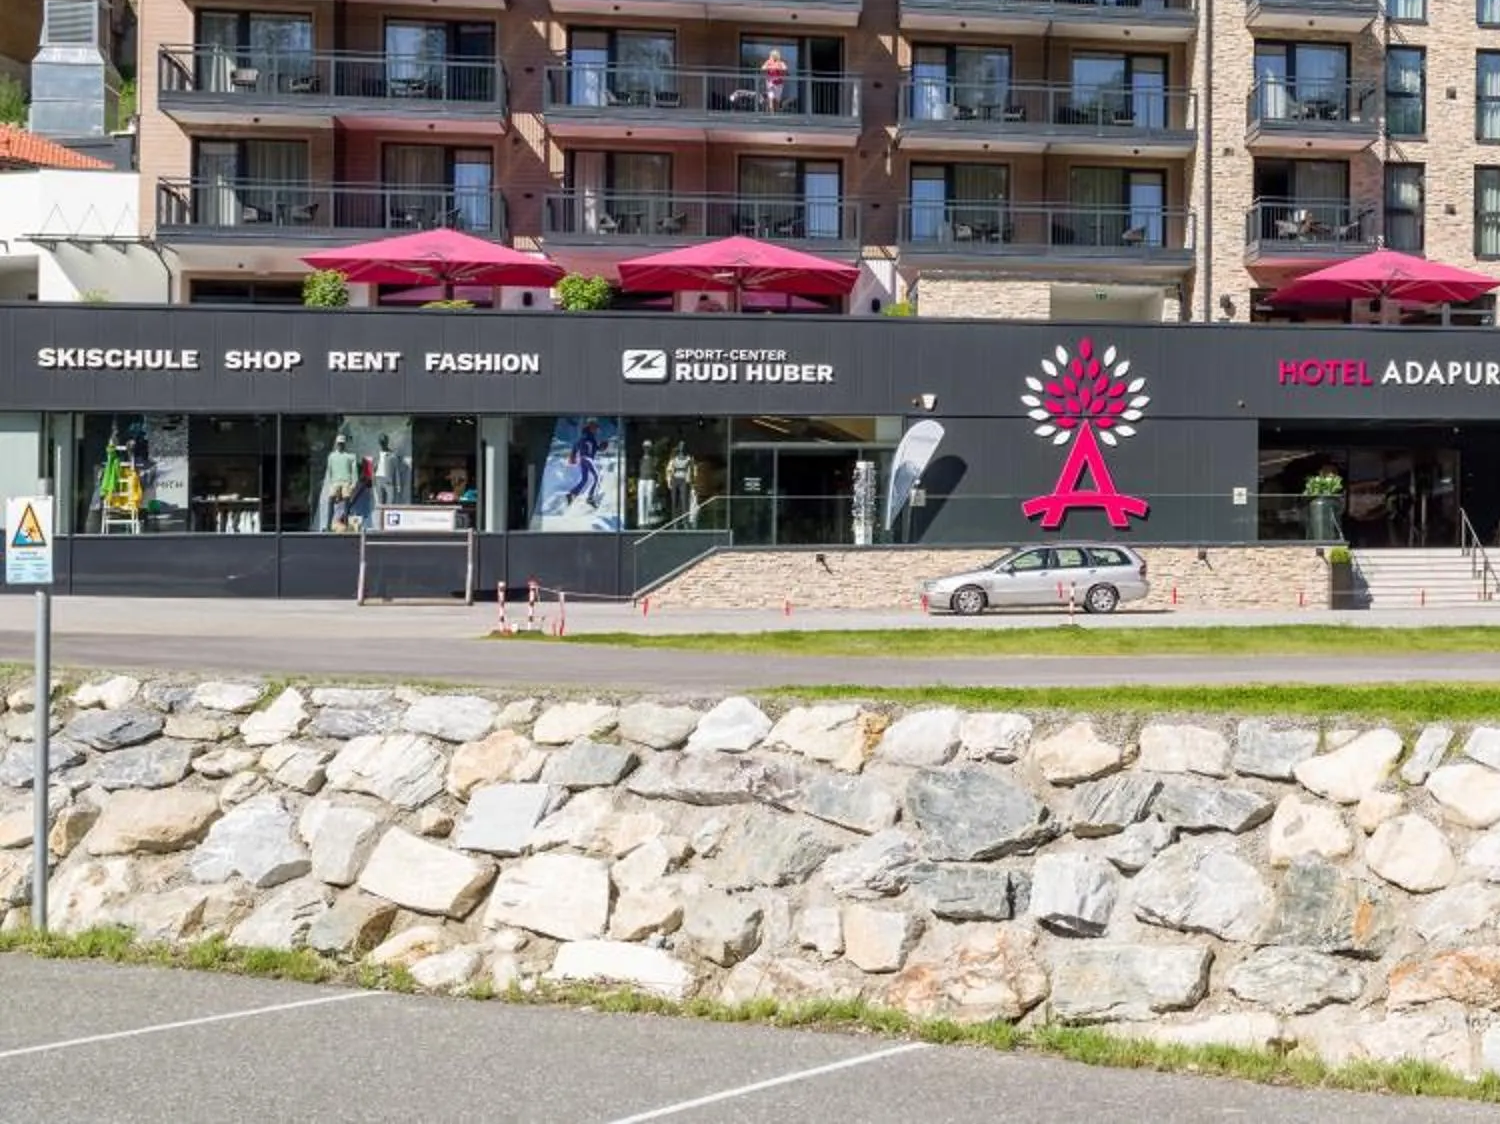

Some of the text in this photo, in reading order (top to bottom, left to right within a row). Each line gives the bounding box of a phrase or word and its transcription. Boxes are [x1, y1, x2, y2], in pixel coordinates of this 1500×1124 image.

[37, 347, 540, 373] SKISCHULE SHOP RENT FASHION
[675, 348, 787, 361] SPORT-CENTER
[675, 363, 834, 383] RUDI HUBER
[1278, 359, 1374, 387] HOTEL
